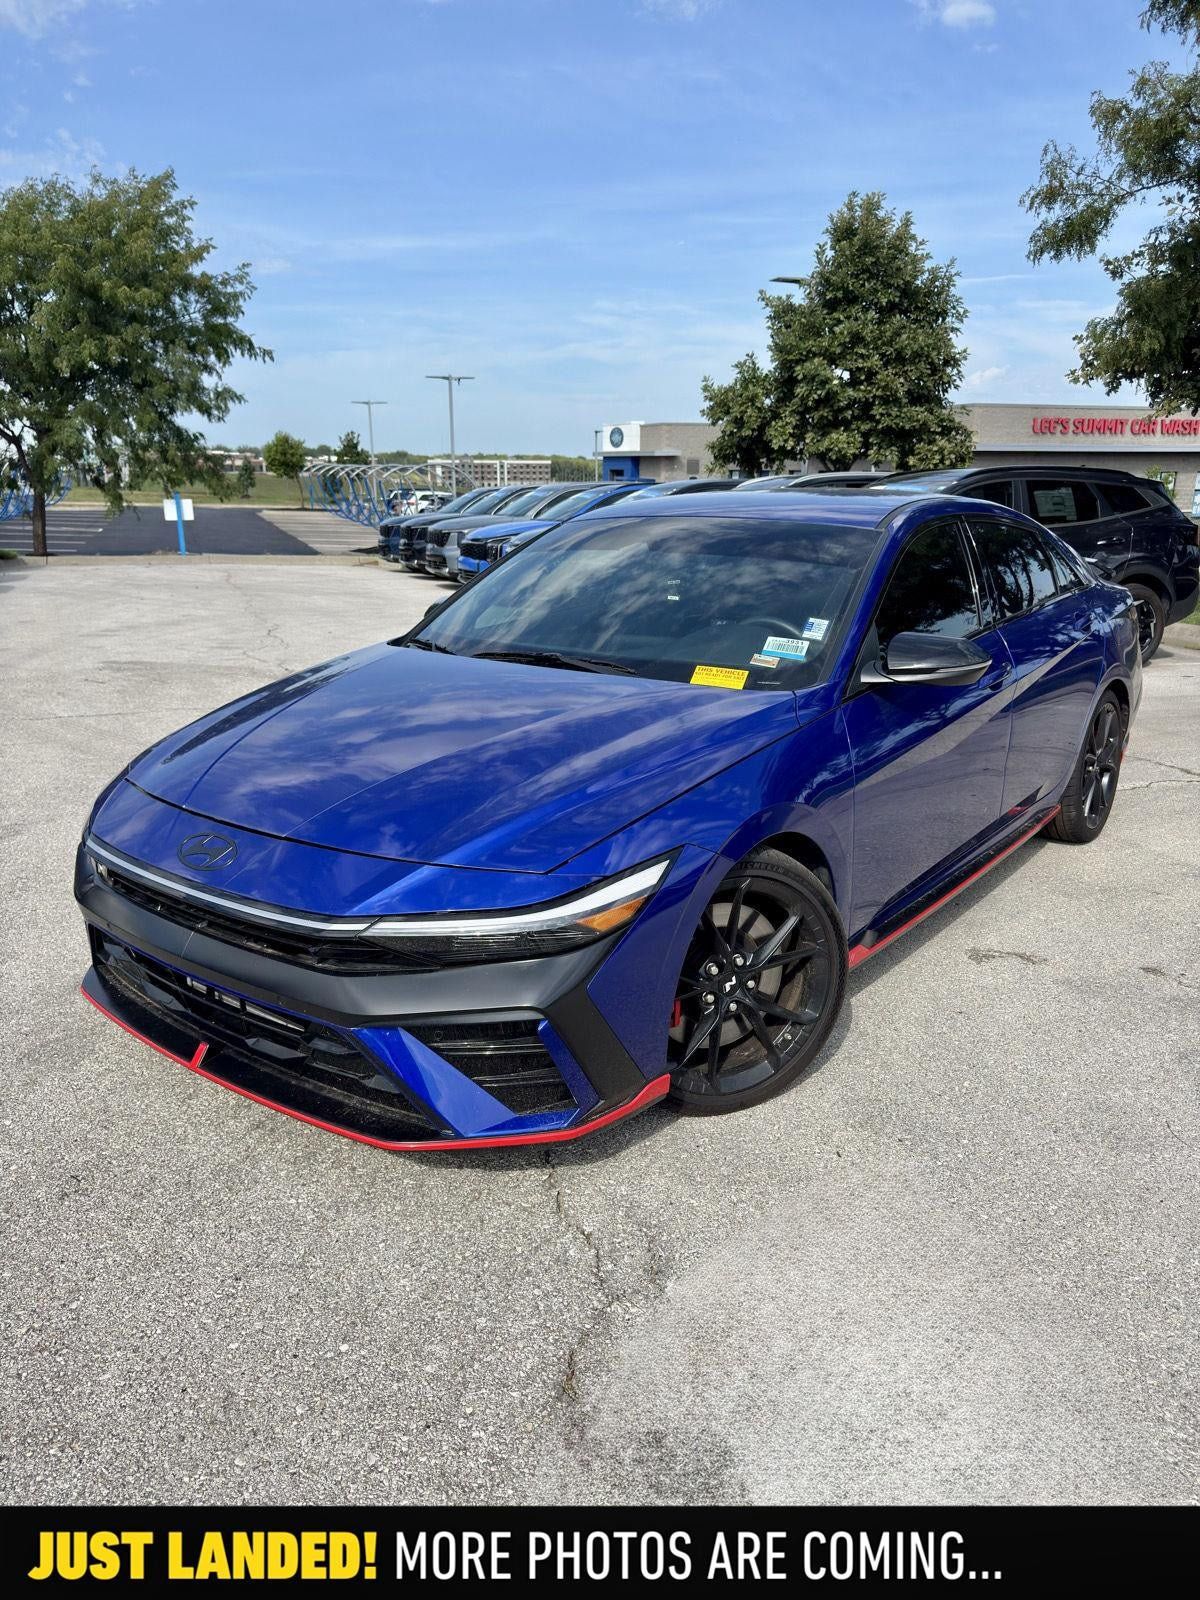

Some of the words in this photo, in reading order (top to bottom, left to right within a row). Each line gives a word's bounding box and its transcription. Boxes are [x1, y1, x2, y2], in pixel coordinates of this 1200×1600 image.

[1032, 417, 1070, 434] LEE'S
[1072, 418, 1129, 434] SUMMIT
[1130, 419, 1158, 435] CAR
[1161, 419, 1200, 435] WASH
[716, 668, 746, 676] VEHICLE
